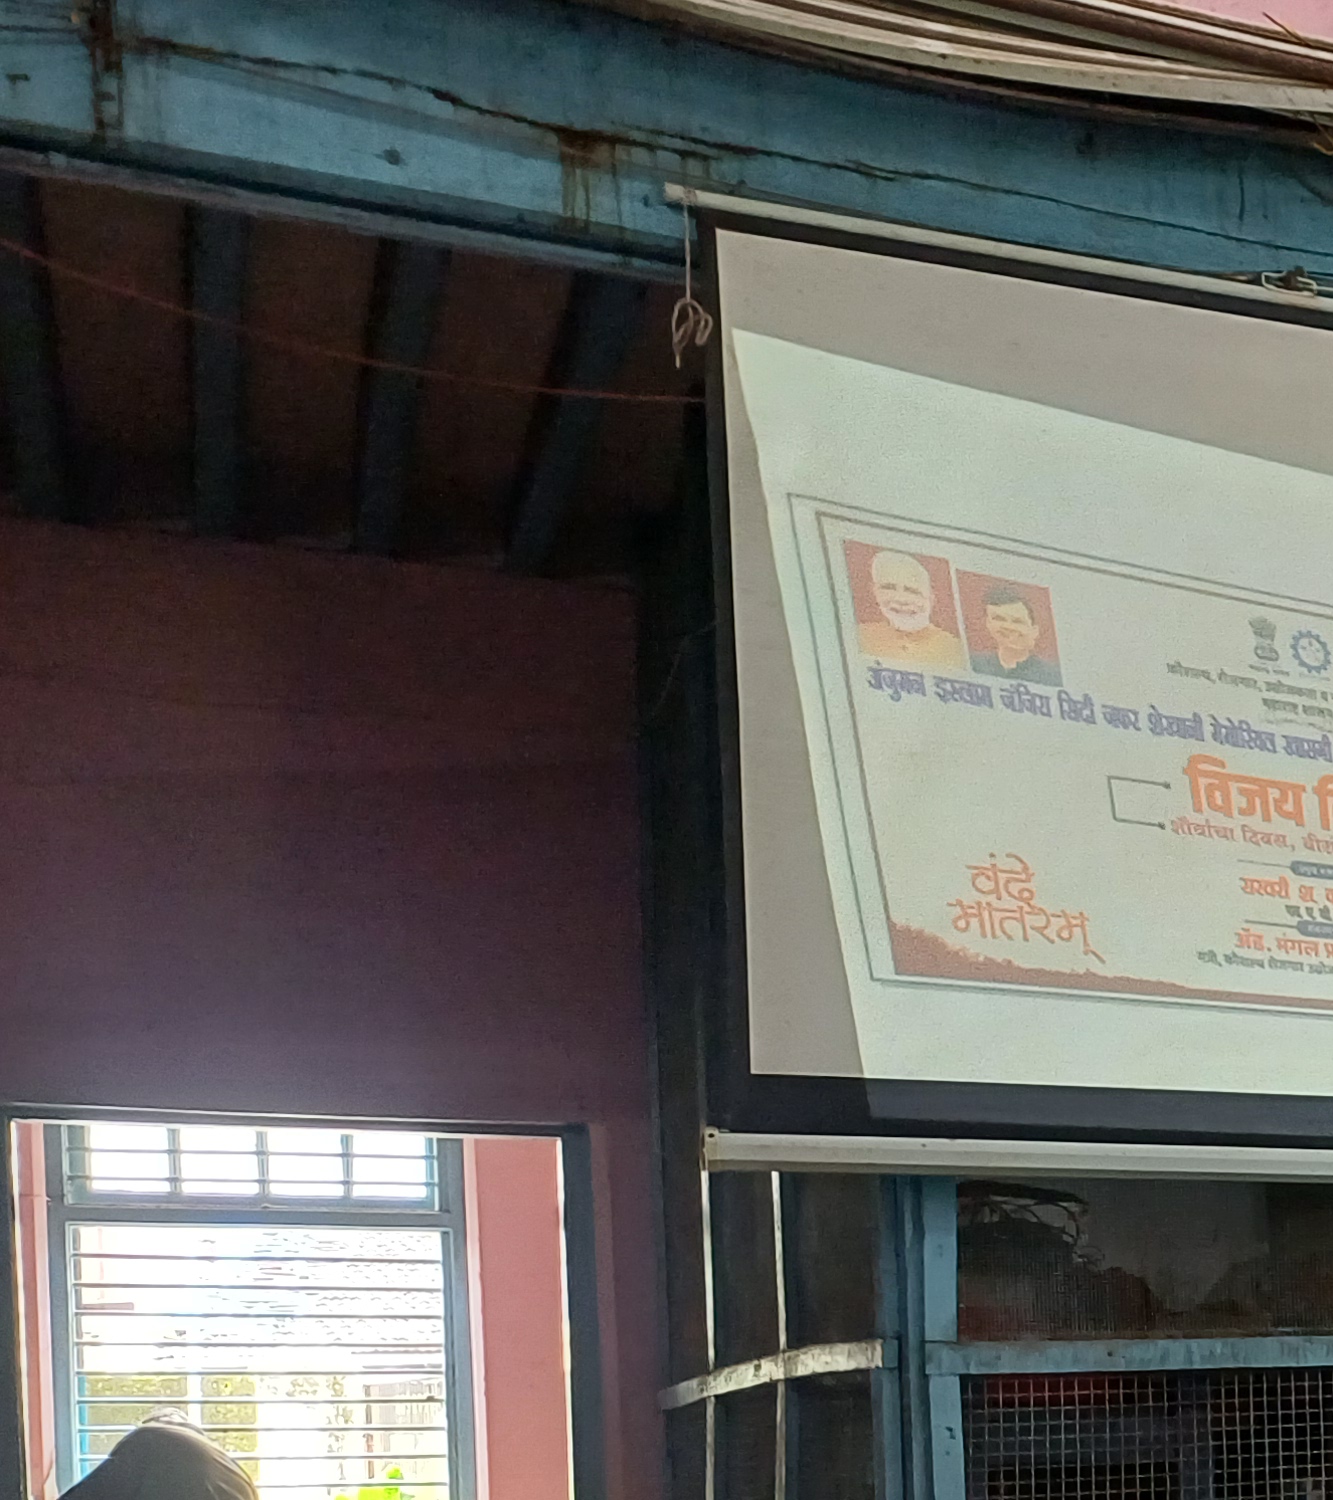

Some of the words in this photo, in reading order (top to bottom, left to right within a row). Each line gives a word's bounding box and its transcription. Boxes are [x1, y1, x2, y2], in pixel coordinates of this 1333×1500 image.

[1182, 753, 1306, 827] विजय
[965, 852, 1036, 903] वंदे
[947, 898, 1106, 965] मातरम्
[1275, 932, 1320, 957] मंगल
